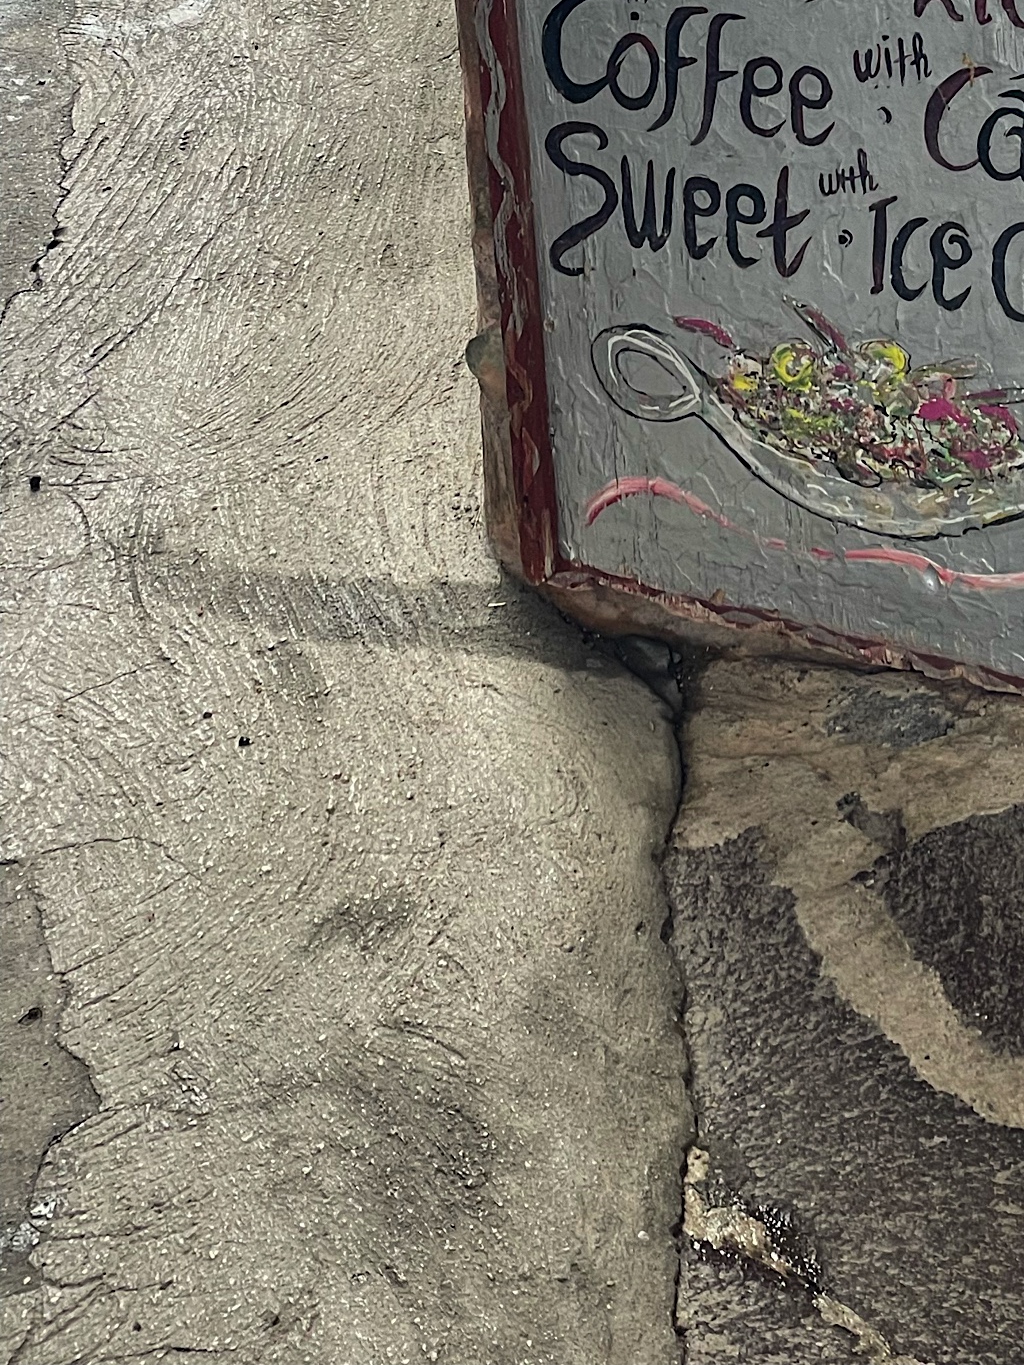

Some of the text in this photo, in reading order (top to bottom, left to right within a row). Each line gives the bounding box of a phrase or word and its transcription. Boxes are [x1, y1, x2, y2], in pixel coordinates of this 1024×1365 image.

[853, 31, 932, 86] with
[545, 121, 813, 282] Sweet
[818, 147, 879, 197] with
[869, 196, 973, 313] Ice
